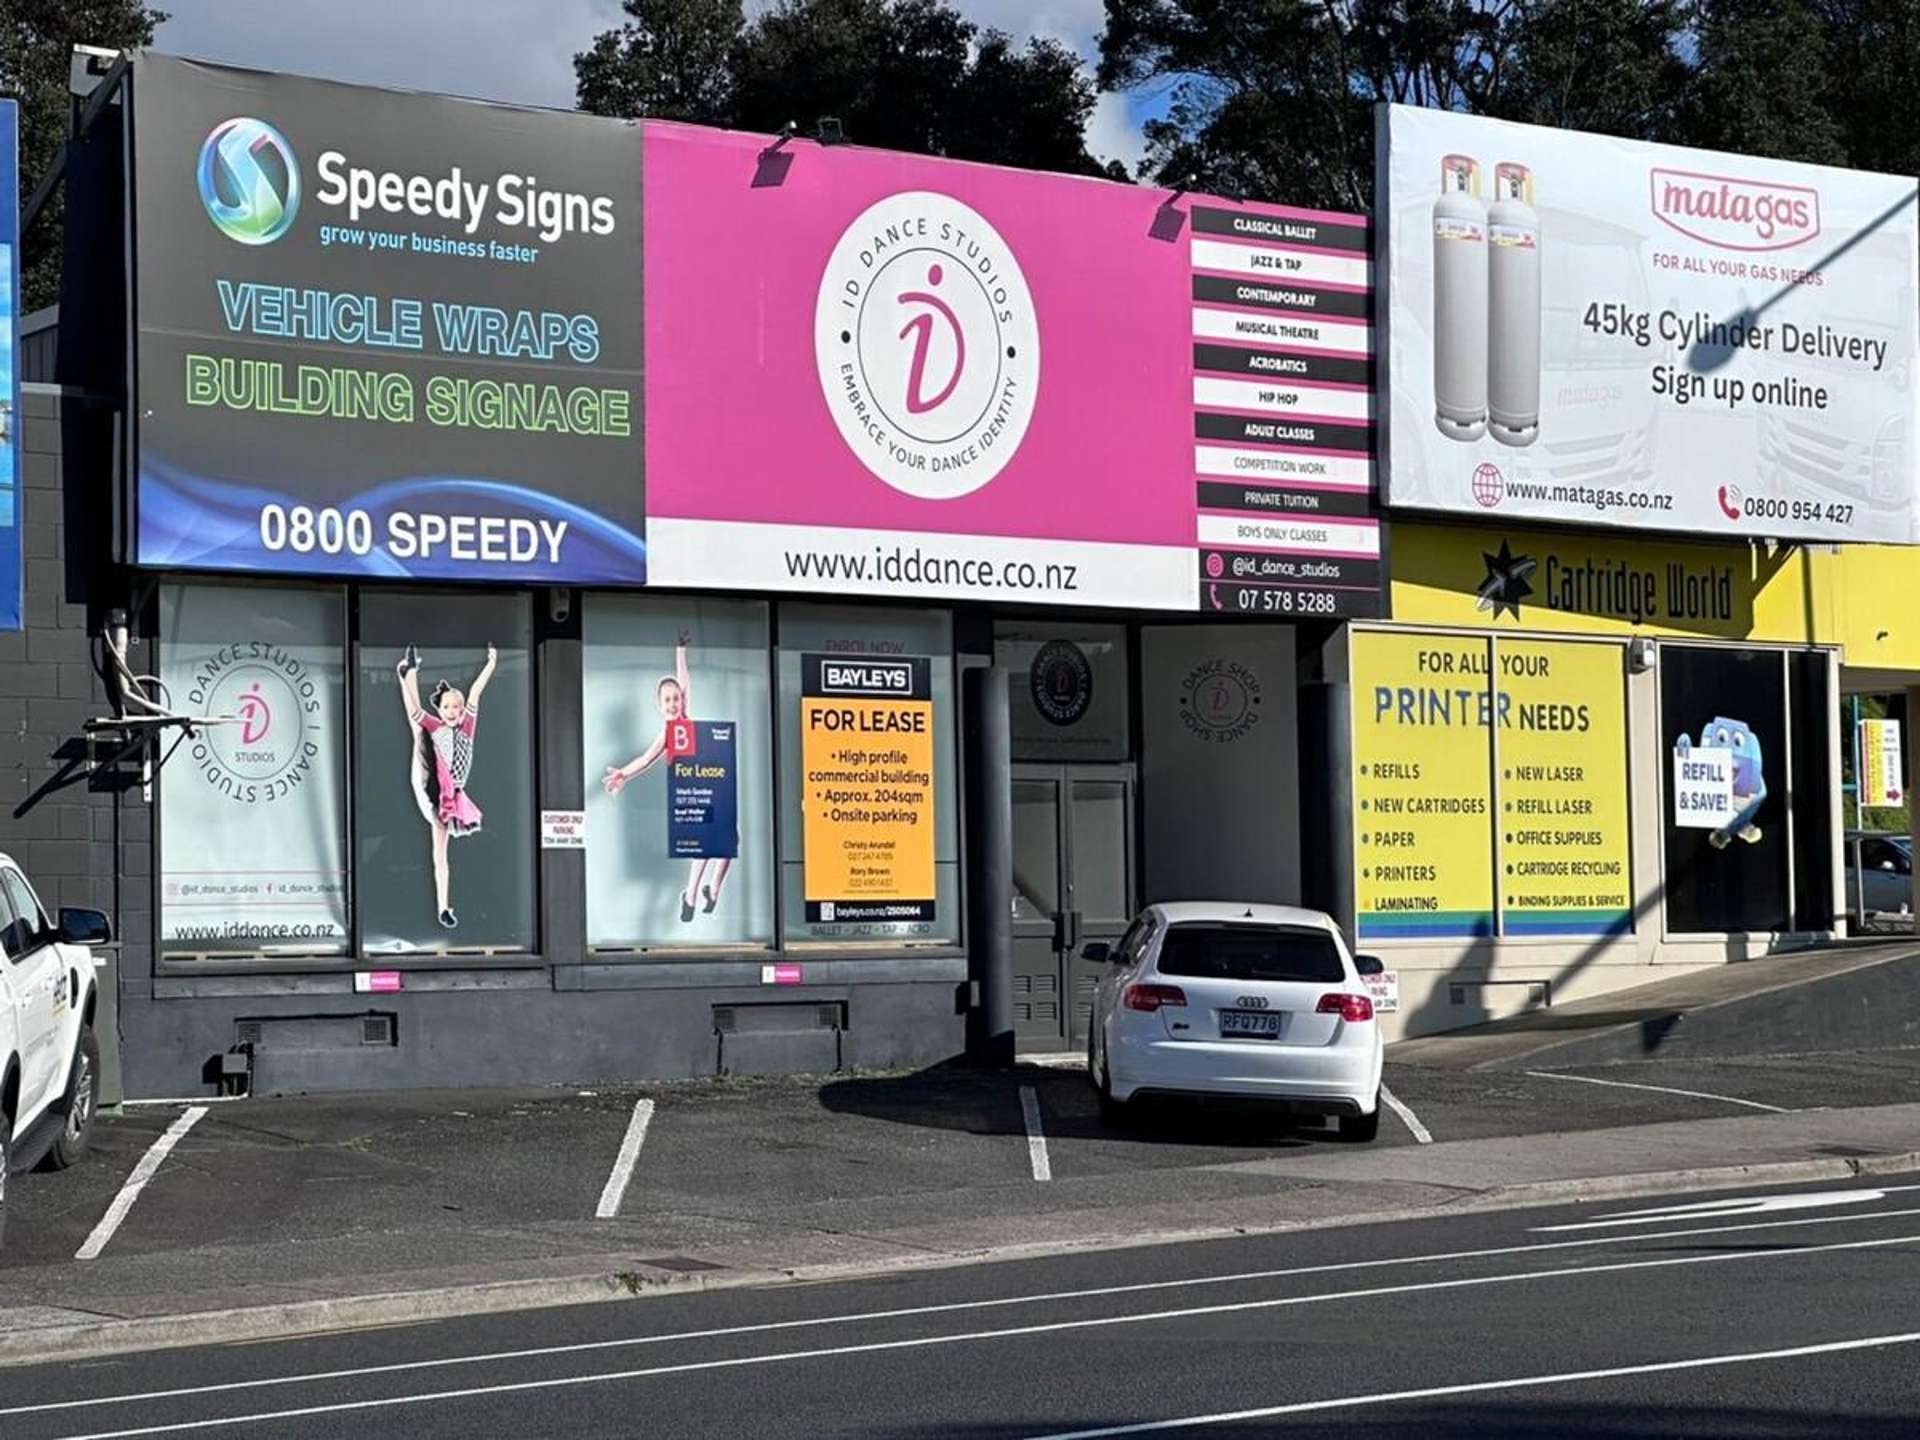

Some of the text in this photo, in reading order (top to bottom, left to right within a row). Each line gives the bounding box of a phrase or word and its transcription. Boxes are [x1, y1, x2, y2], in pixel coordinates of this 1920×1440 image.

[316, 152, 615, 242] Speedy Signs
[1234, 218, 1317, 240] CLASSICAL BALLET
[320, 225, 539, 263] grow your business faster
[859, 218, 927, 268] DANCE
[940, 223, 1012, 323] STUDIOS
[1251, 255, 1302, 271] JAZZ & TAP
[1653, 253, 1823, 286] FOR ALL YOUR GAS NEEDS
[1236, 287, 1316, 307] CONTEMPORARY
[217, 280, 600, 362] VEHICLE WRAPS
[1235, 321, 1319, 340] MUSICAL THEATRE
[1583, 301, 1887, 371] 45kg Cylinder Delivery
[1249, 356, 1307, 373] ACROBATICS
[186, 354, 630, 436] BUILDING SIGNAGE
[1651, 366, 1828, 409] Sign up online
[1259, 391, 1298, 405] HIP HOP
[840, 363, 1017, 472] EMBRACE YOUR DANCE IDENTITY
[1245, 424, 1315, 441] ADULT CLASSES
[1234, 456, 1326, 474] COMPETITION WORK
[1245, 491, 1319, 508] PRIVATE TUITION
[1506, 480, 1673, 511] www.matagas.co.nz
[1744, 496, 1854, 525] 0800 954 427
[260, 503, 568, 563] 0800 SPEEDY
[1238, 525, 1327, 542] BOYS ONLY CLASSES
[785, 547, 1078, 590] www.iddance.co.nz
[1233, 557, 1340, 577] @id_dance_studios
[1546, 554, 1731, 625] Cartridge World
[1239, 590, 1336, 612] 07 578 5288
[1419, 651, 1549, 677] FOR ALL YOUR
[189, 642, 242, 705] DANCE
[250, 641, 320, 713] STUDIOS
[827, 668, 906, 688] BAYLEYS
[1375, 687, 1589, 732] PRINTER NEEDS
[810, 709, 925, 732] FOR LEASE
[674, 725, 689, 751] B
[235, 752, 275, 763] STUDIOS
[838, 750, 908, 766] High profile
[264, 742, 318, 801] DANCE
[675, 763, 726, 778] For Lease
[808, 770, 929, 786] commercial building
[1373, 763, 1420, 779] REFILLS
[1516, 766, 1584, 781] NEW LASER
[1682, 763, 1725, 782] REFILL
[824, 789, 923, 805] Approx. 204sqm
[1374, 798, 1486, 814] NEW CARTRIDGES
[1517, 799, 1592, 814] REFILL LASER
[1680, 791, 1728, 811] & SAVE!
[831, 809, 918, 825] Onsite parking
[1374, 832, 1415, 847] PAPER
[1516, 831, 1603, 846] OFFICE SUPPLIES
[1375, 866, 1436, 881] PRINTERS
[1517, 862, 1621, 876] CARTRIDGE RECYCLING
[1375, 897, 1438, 911] LAMINATING
[1518, 896, 1550, 906] BINDING
[1552, 896, 1586, 906] SUPPLIES
[1595, 895, 1625, 906] SERVICE
[176, 921, 335, 940] www.iddance.co.nz
